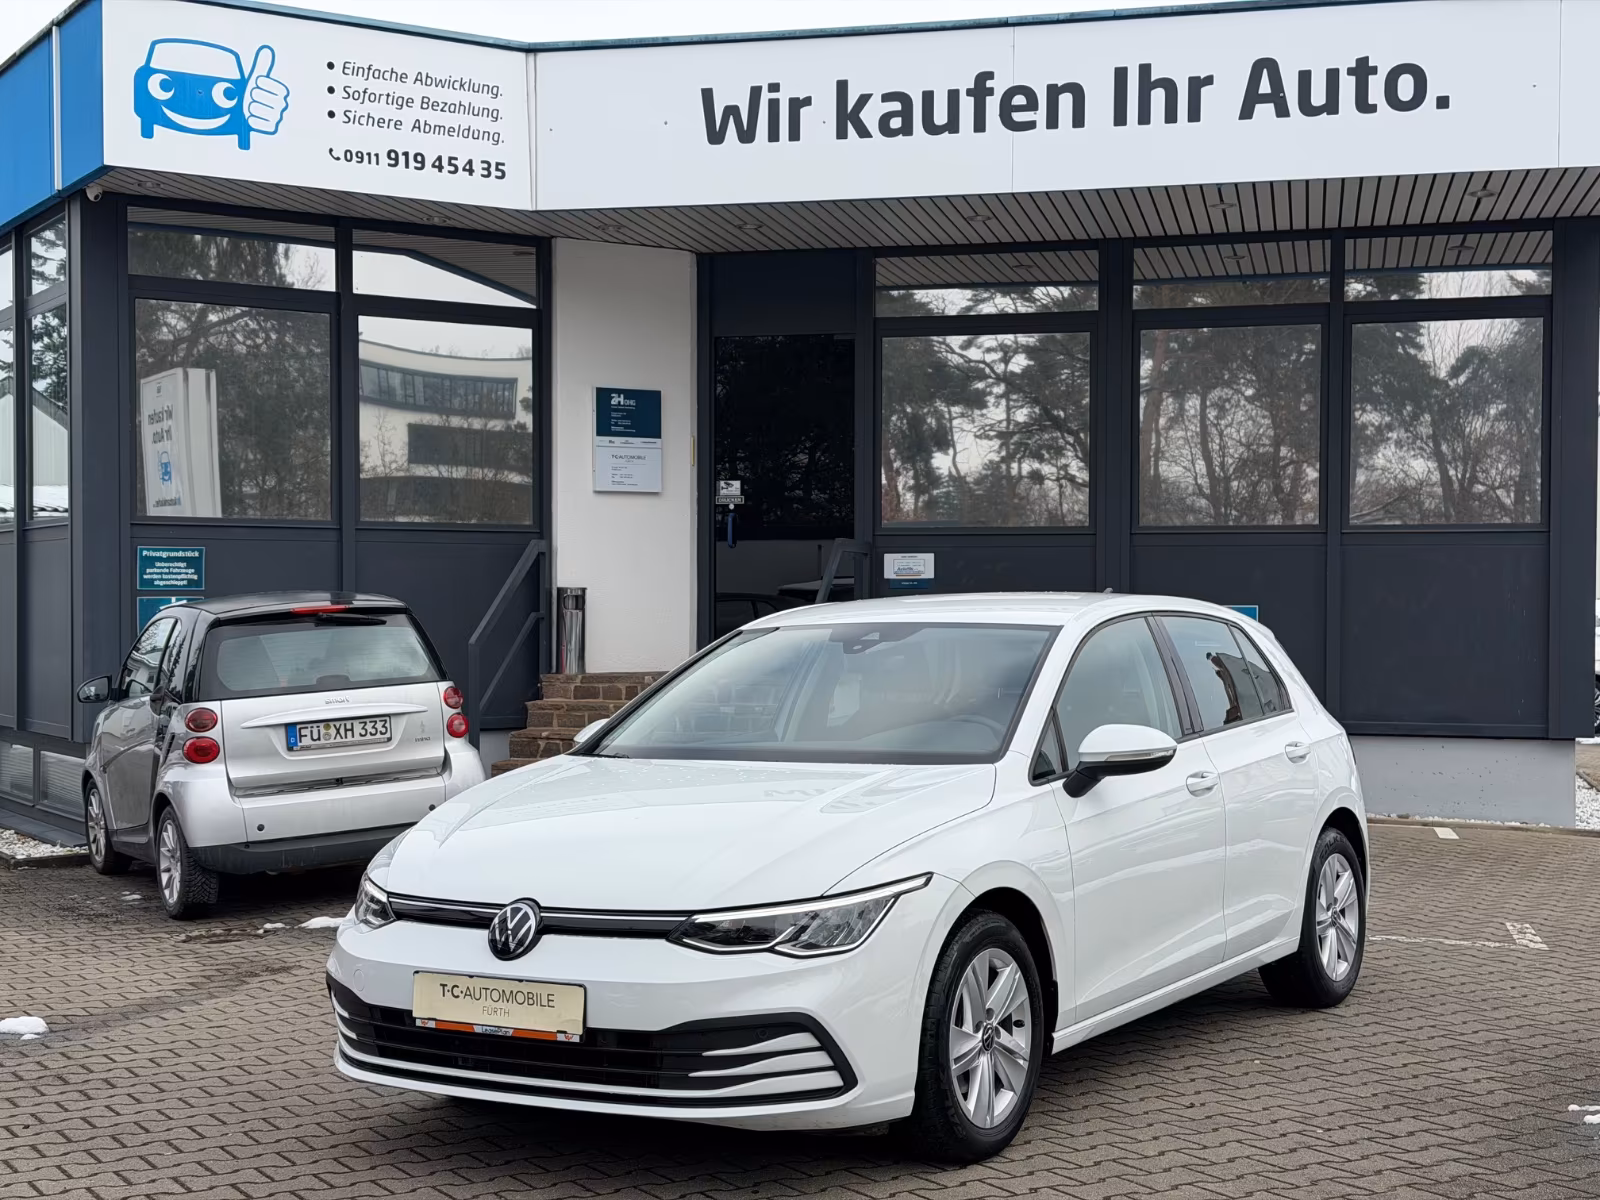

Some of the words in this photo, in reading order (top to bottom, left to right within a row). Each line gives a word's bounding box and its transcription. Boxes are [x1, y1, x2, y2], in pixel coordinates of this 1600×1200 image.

[342, 61, 408, 83] Einfache
[413, 71, 503, 99] Abwicklung.
[342, 86, 414, 110] Sofortige
[420, 96, 503, 122] Bezahlung.
[700, 82, 812, 146] Wir
[835, 71, 1086, 141] kaufen
[1113, 63, 1214, 127] Ihr
[1238, 56, 1450, 121] Auto.
[342, 110, 403, 131] Sichere
[411, 119, 504, 145] Abmeldung.
[344, 149, 380, 165] 0911
[386, 149, 426, 171] 919
[142, 550, 200, 558] Privatgrundstück
[298, 725, 321, 744] FÜ
[333, 722, 355, 741] XH
[358, 719, 389, 737] 333
[482, 1005, 510, 1018] FÜRTH
[481, 1025, 511, 1036] LeasePlan
